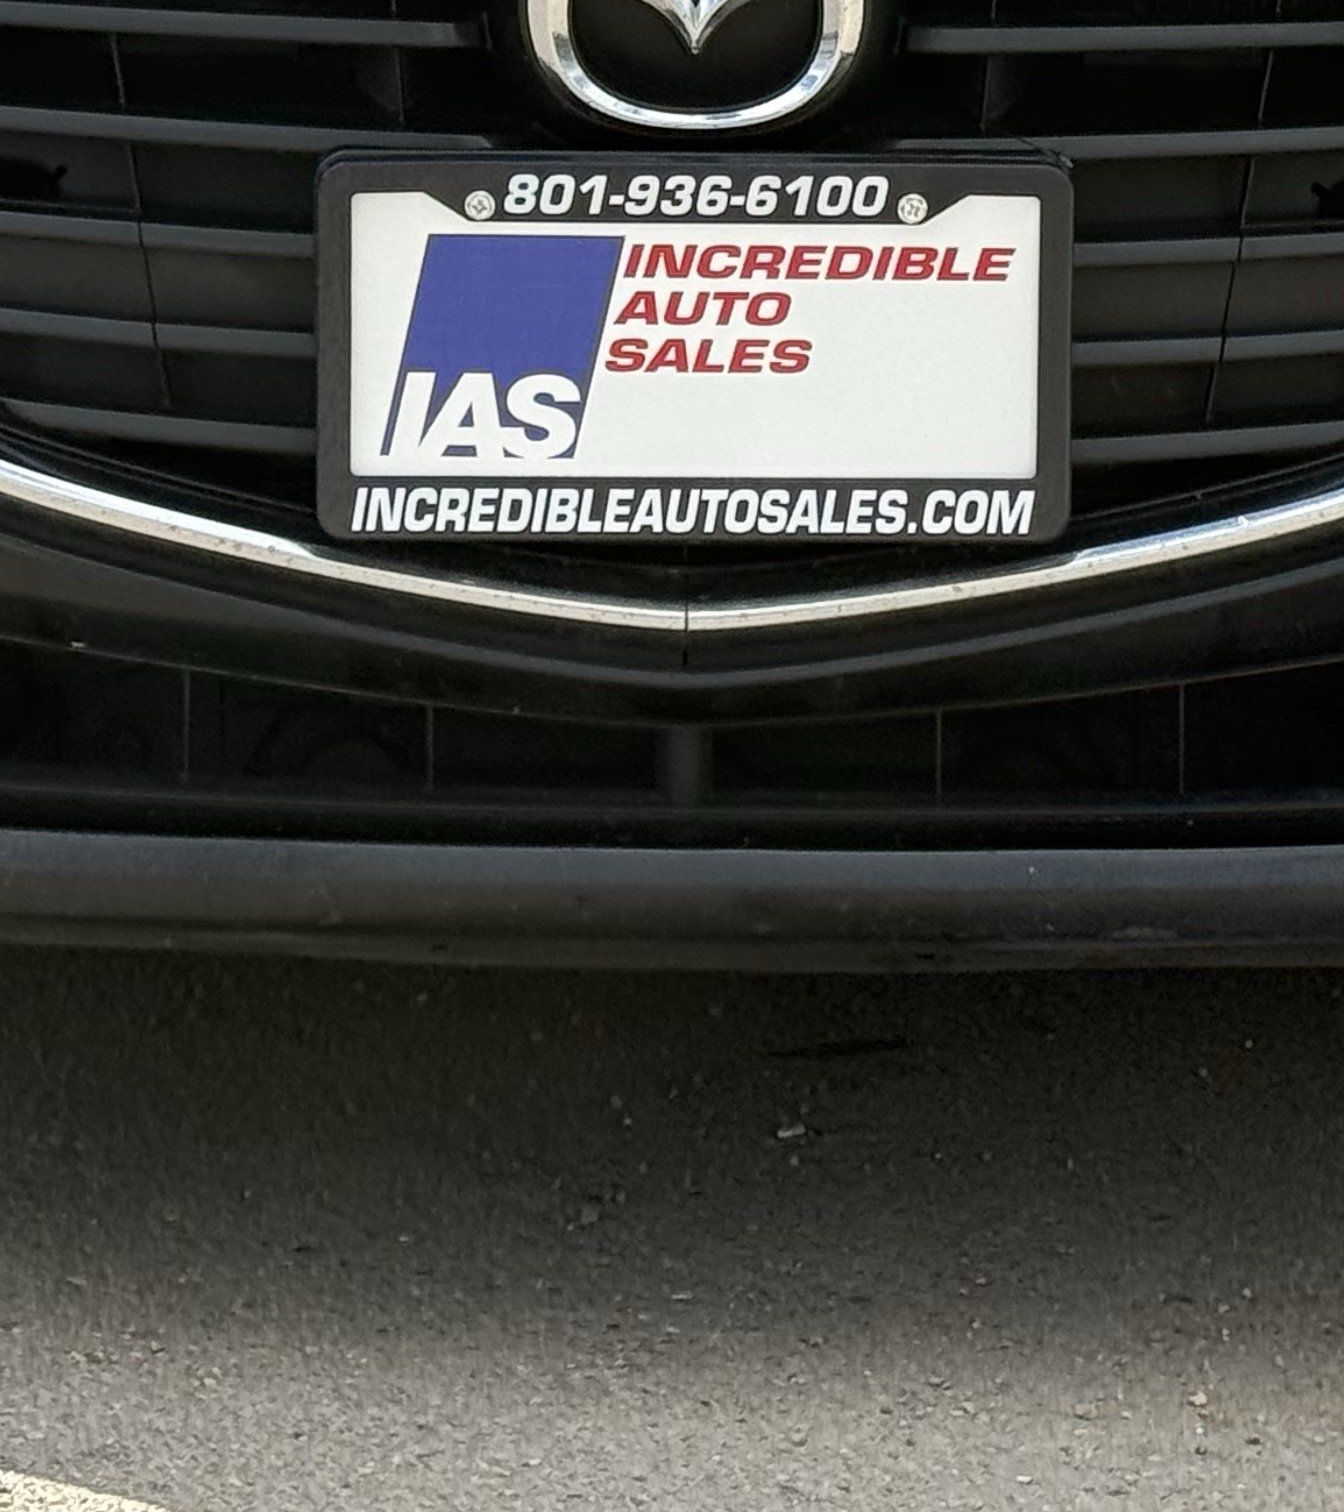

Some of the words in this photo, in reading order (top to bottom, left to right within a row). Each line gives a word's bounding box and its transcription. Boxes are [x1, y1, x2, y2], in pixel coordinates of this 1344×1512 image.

[503, 173, 889, 217] 801-936-6100
[624, 244, 1016, 281] INCREDIBLE
[614, 291, 792, 326] AUTO
[605, 338, 813, 373] SALES
[393, 371, 582, 460] IAS
[351, 487, 1036, 536] INCREDIBLEAUTOSALES.COM
